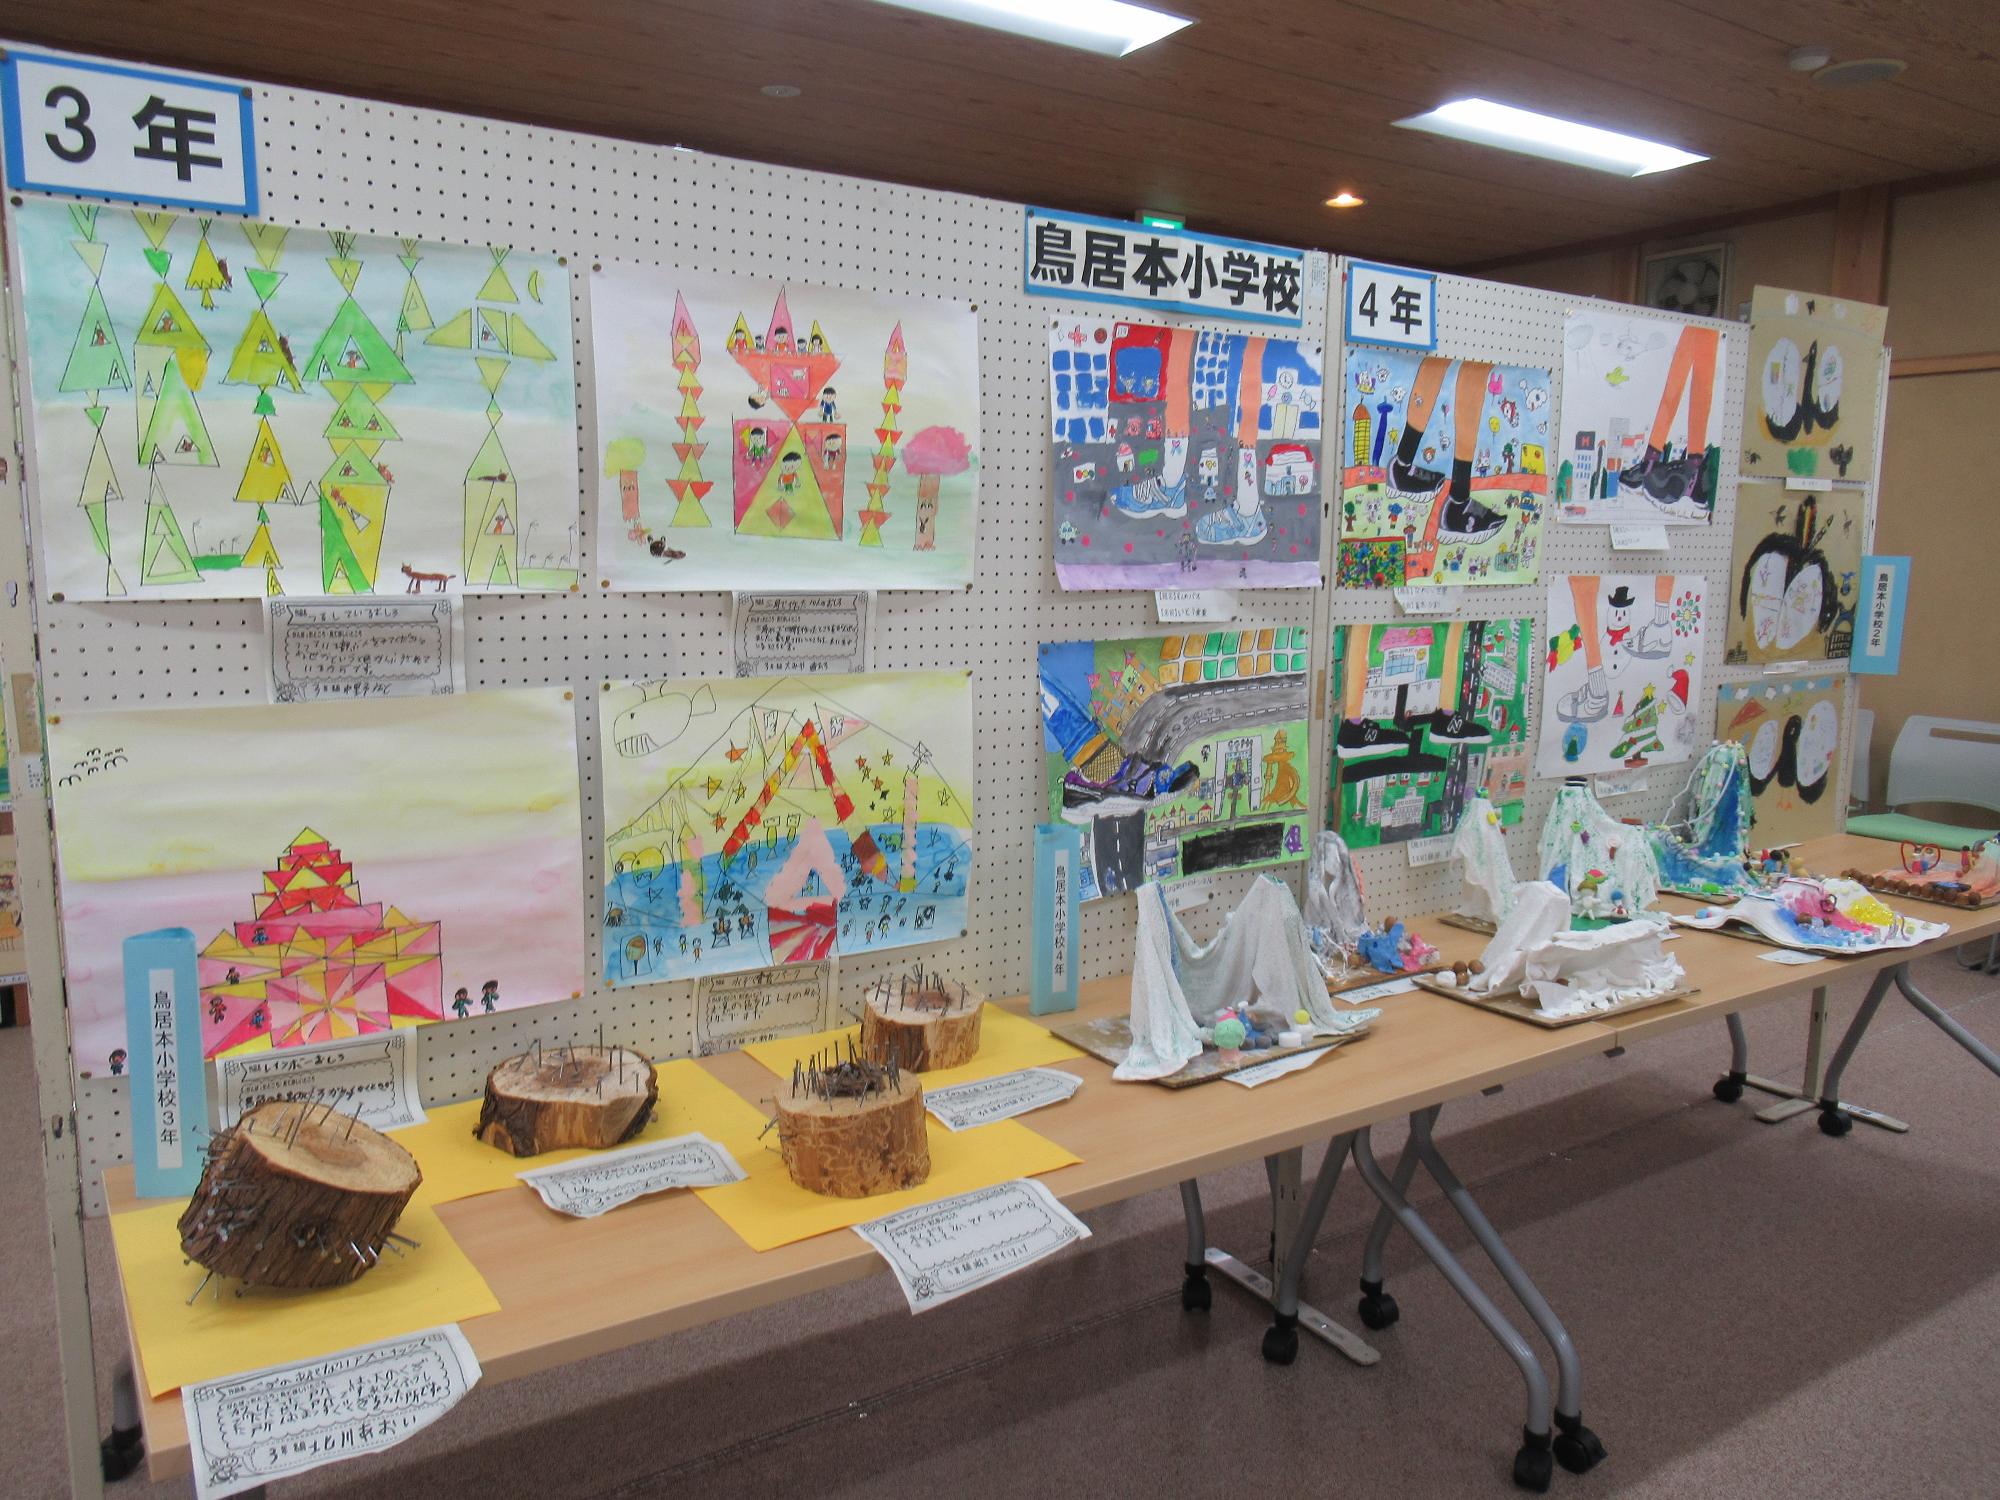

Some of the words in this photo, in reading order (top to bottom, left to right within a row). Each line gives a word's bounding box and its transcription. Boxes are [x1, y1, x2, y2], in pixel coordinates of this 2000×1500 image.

[44, 84, 224, 182] 3年
[1030, 221, 1302, 317] 鳥居本小学校
[1358, 282, 1423, 336] 4年
[1870, 573, 1889, 647] 鳥居本小学校2年
[1054, 865, 1067, 977] 鳥居本小学校4年
[153, 990, 179, 1146] 鳥居本小学校3年
